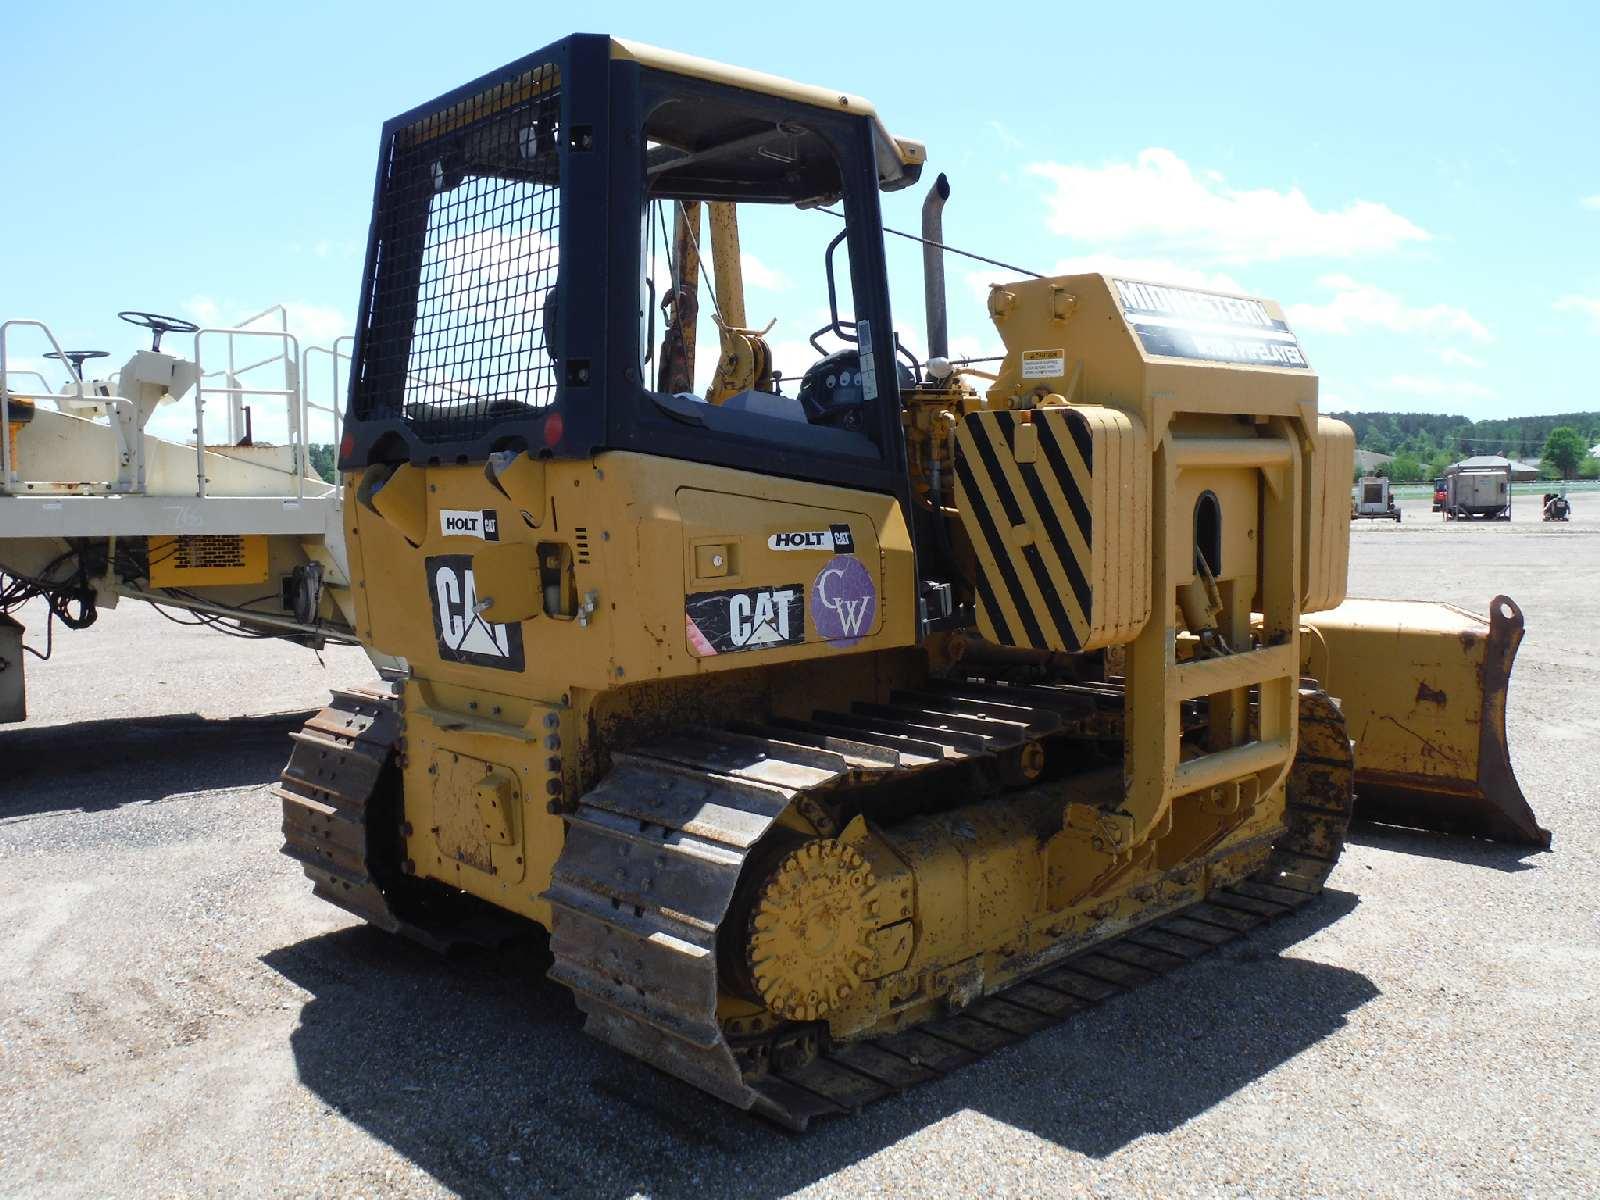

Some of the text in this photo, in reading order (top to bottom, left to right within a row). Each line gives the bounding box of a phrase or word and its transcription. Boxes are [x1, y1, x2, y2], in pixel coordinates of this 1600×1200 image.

[447, 518, 496, 532] HOLT CAT
[775, 531, 849, 546] HOLT CAT
[435, 566, 509, 657] CA
[730, 590, 795, 646] CAT
